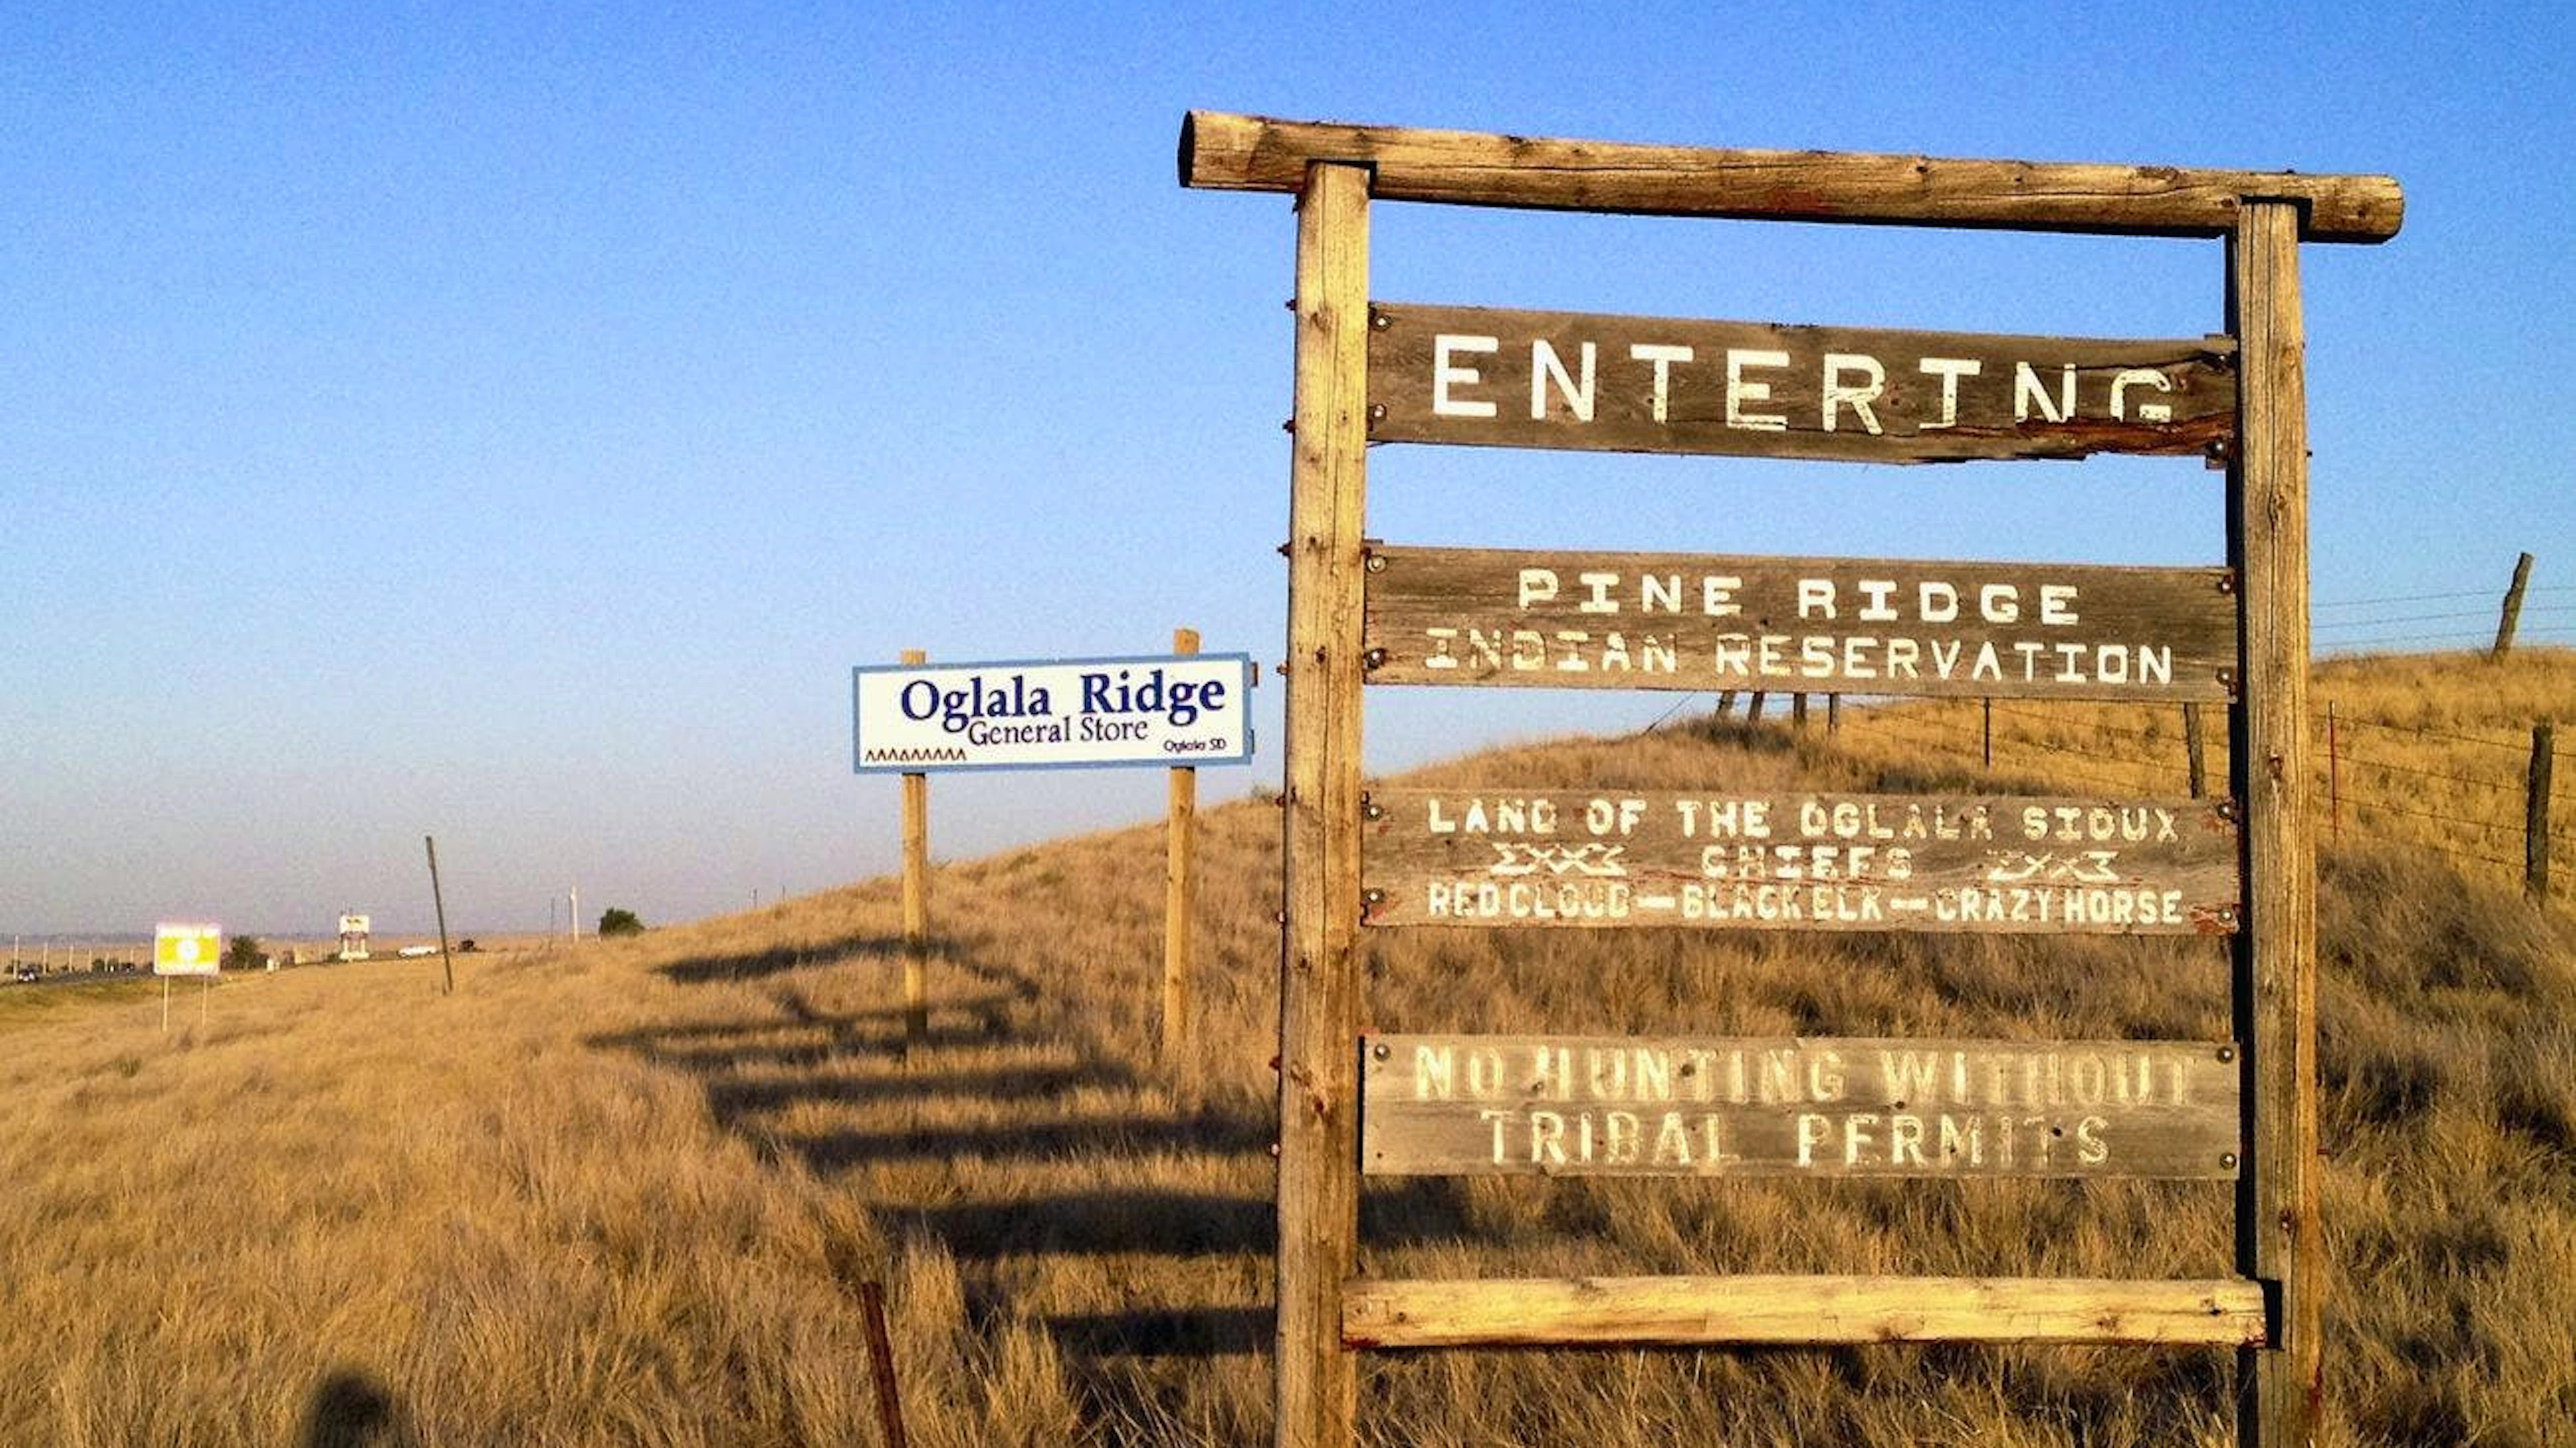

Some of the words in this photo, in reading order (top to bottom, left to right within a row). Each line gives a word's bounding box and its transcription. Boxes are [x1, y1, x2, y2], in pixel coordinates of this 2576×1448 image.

[1433, 334, 2171, 435] ENTERING
[1518, 569, 1743, 616] PINE
[1798, 579, 2079, 625] RIDGE
[1426, 628, 1677, 673] INDIAN
[1715, 632, 2171, 685] RESERVATION
[901, 674, 1052, 733] Oglala
[1080, 669, 1226, 726] Ridge
[967, 716, 1071, 746] General
[1080, 716, 1148, 741] Store
[1428, 798, 1557, 834] LAND
[1585, 799, 1648, 836] OF
[1676, 799, 1770, 838] THE
[1799, 801, 1992, 840] OGLALA
[2022, 805, 2178, 842] SIOUX
[1701, 845, 1913, 880] CHIEFS
[2063, 889, 2184, 925] HORSE
[1416, 1044, 1504, 1101] NO
[1534, 1044, 1845, 1104] HUNTING
[1882, 1050, 2200, 1105] WITHOUT
[1480, 1111, 1741, 1166] TRIBAL
[1796, 1113, 2111, 1167] PERMITS
